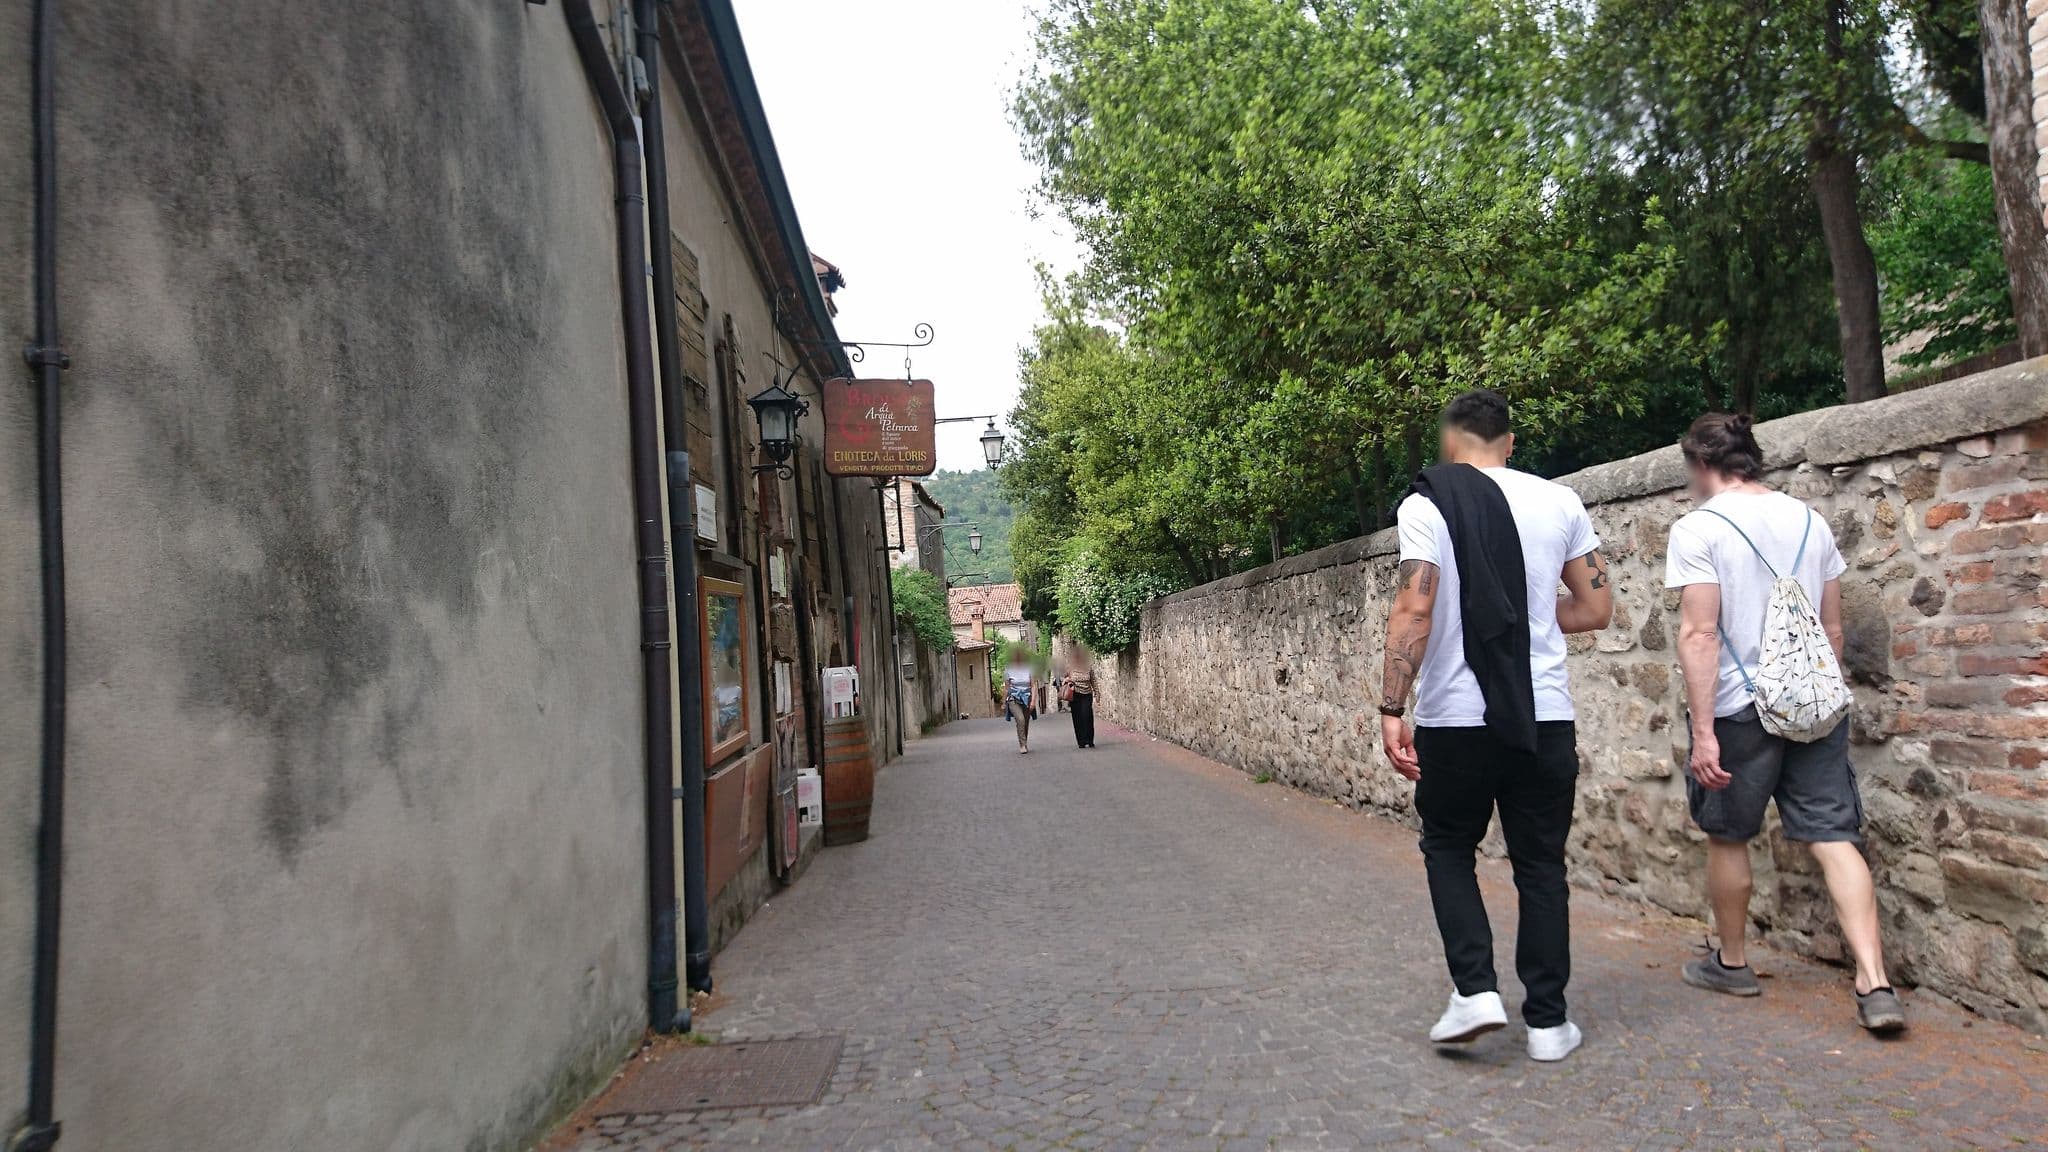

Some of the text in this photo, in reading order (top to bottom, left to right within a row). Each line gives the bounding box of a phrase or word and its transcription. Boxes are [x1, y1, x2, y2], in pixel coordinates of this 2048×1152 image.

[834, 450, 927, 462] ENOTECA da LORIS
[871, 464, 904, 472] PRODOTTI
